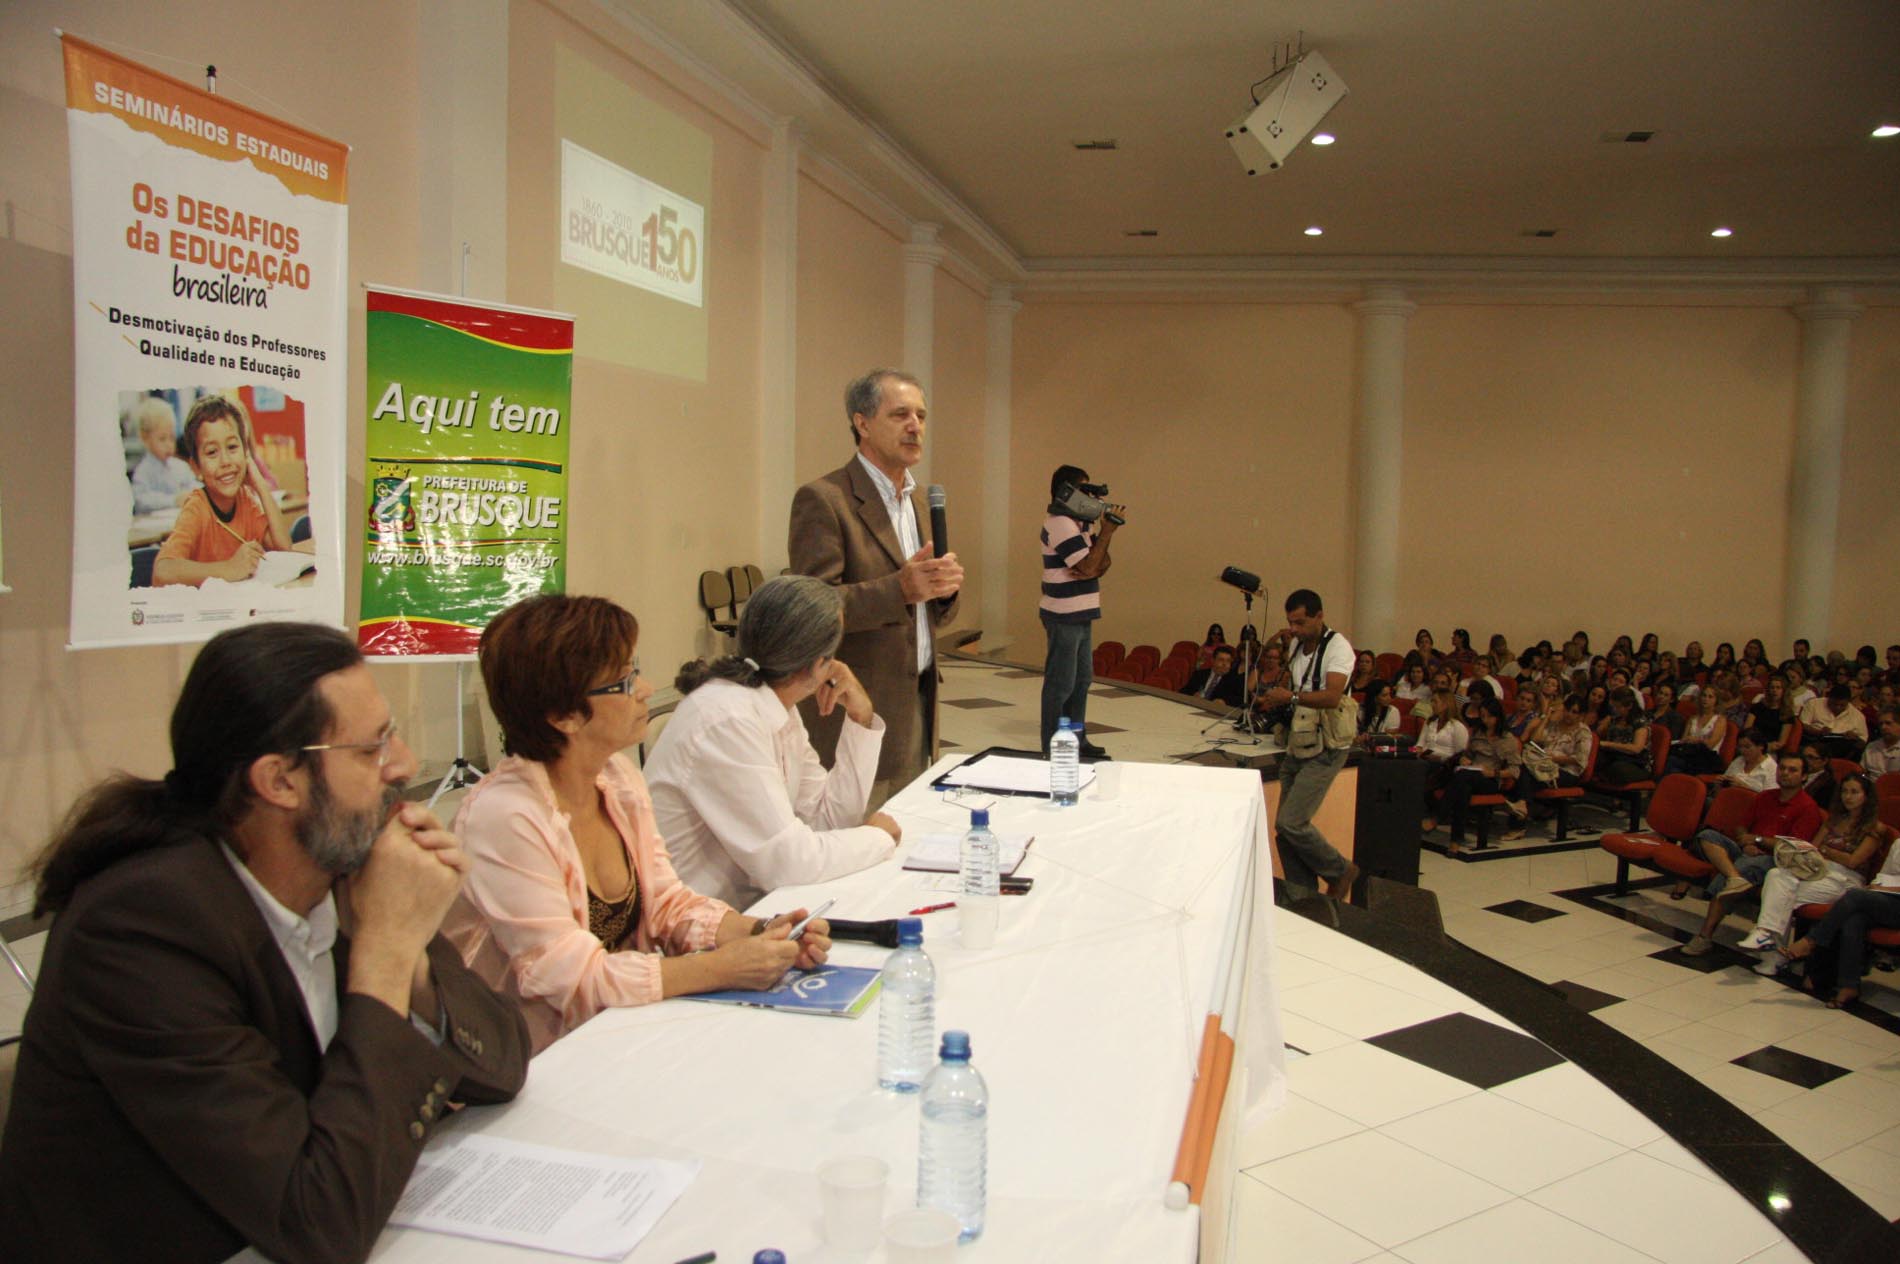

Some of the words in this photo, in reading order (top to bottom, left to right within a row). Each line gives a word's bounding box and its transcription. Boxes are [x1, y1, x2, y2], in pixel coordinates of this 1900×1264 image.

[94, 81, 229, 146] SEMINÁRIOS
[236, 132, 329, 180] ESTADUAIS
[132, 182, 169, 219] Os
[177, 194, 300, 254] DESAFIOS
[568, 208, 651, 269] BRUSQUE
[642, 204, 697, 284] 150
[126, 219, 160, 254] da
[169, 229, 311, 290] EDUCAÇÃO
[172, 264, 268, 310] brasileira
[108, 307, 220, 343] Desmotivação
[223, 330, 248, 347] dos
[251, 334, 327, 361] Professores
[139, 339, 216, 366] Qualidade
[219, 355, 236, 369] na
[239, 356, 301, 381] Educação
[372, 382, 480, 434] Aqui
[489, 395, 561, 436] tem
[420, 491, 560, 529] BRUSQUE
[423, 475, 507, 493] PREFEITURA
[510, 480, 528, 494] DE
